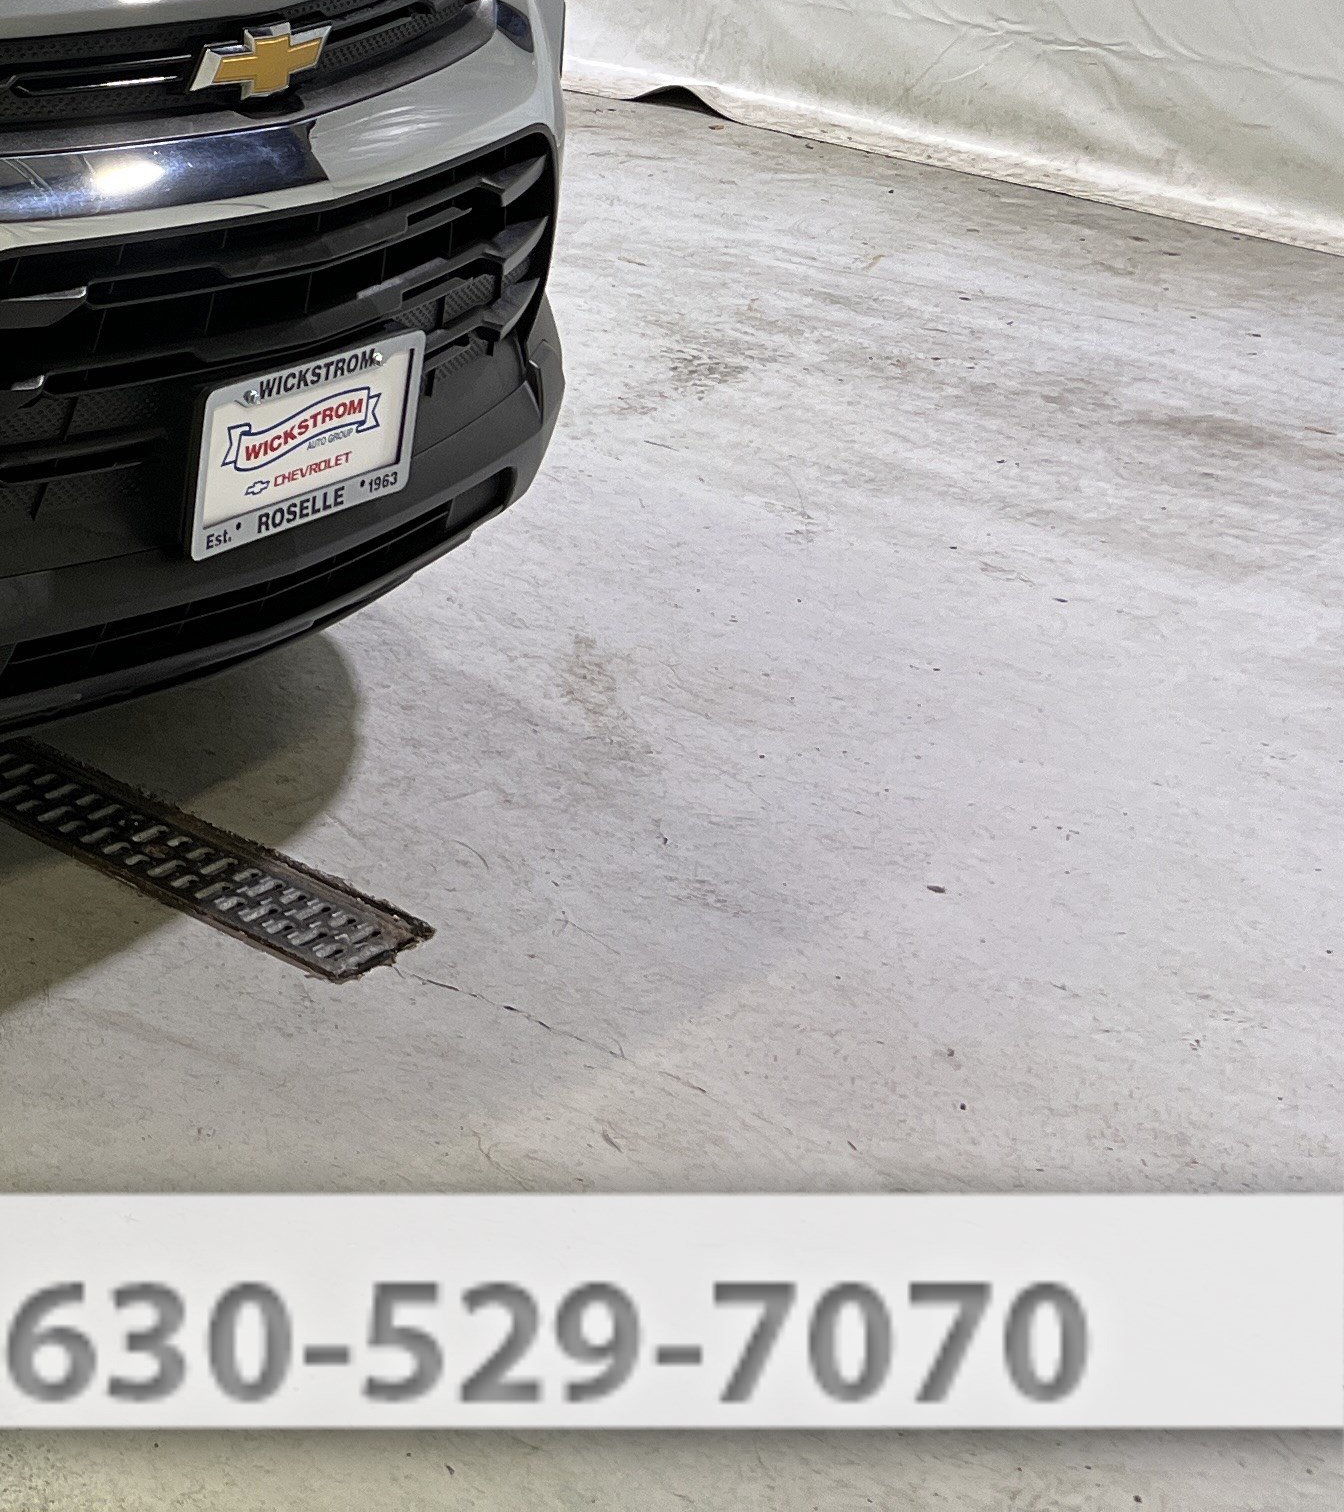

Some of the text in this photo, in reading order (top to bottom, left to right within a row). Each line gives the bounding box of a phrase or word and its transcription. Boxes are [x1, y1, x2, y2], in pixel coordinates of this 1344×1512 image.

[258, 347, 376, 400] WICKSTROM
[244, 397, 365, 462] WICKSTROM
[306, 427, 354, 451] AUTO GROUP
[273, 450, 353, 488] CHEVROLET
[205, 471, 399, 550] Est. ROSELLE 1963
